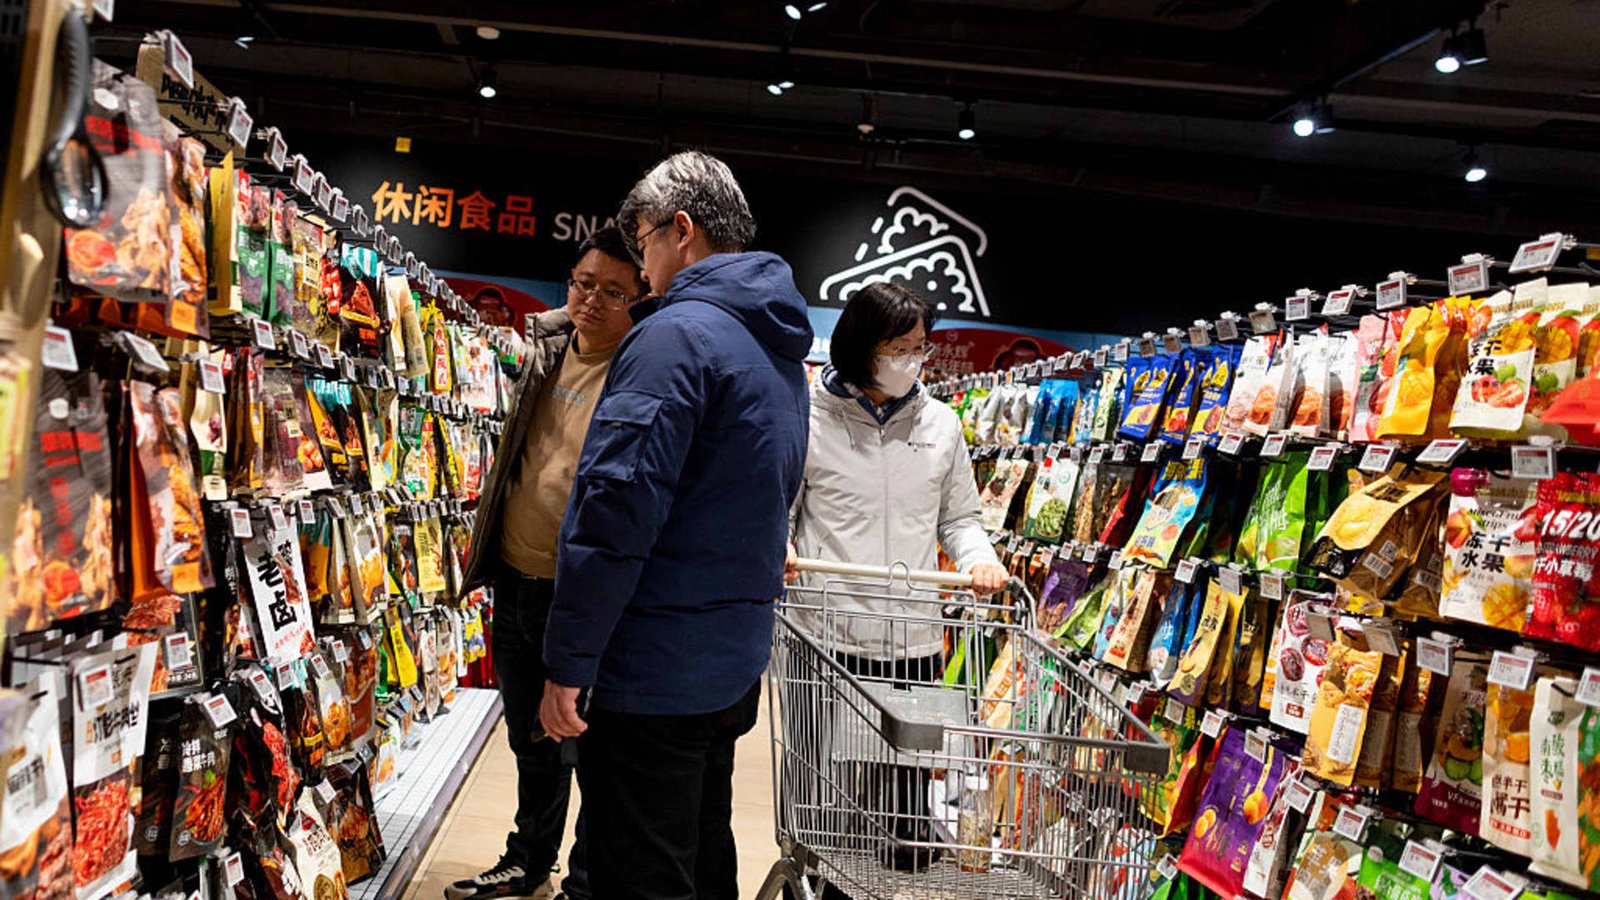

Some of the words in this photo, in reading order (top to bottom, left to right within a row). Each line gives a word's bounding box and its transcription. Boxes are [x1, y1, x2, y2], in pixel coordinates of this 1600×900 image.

[371, 180, 537, 236] 休闲食品
[1461, 550, 1505, 573] 水果
